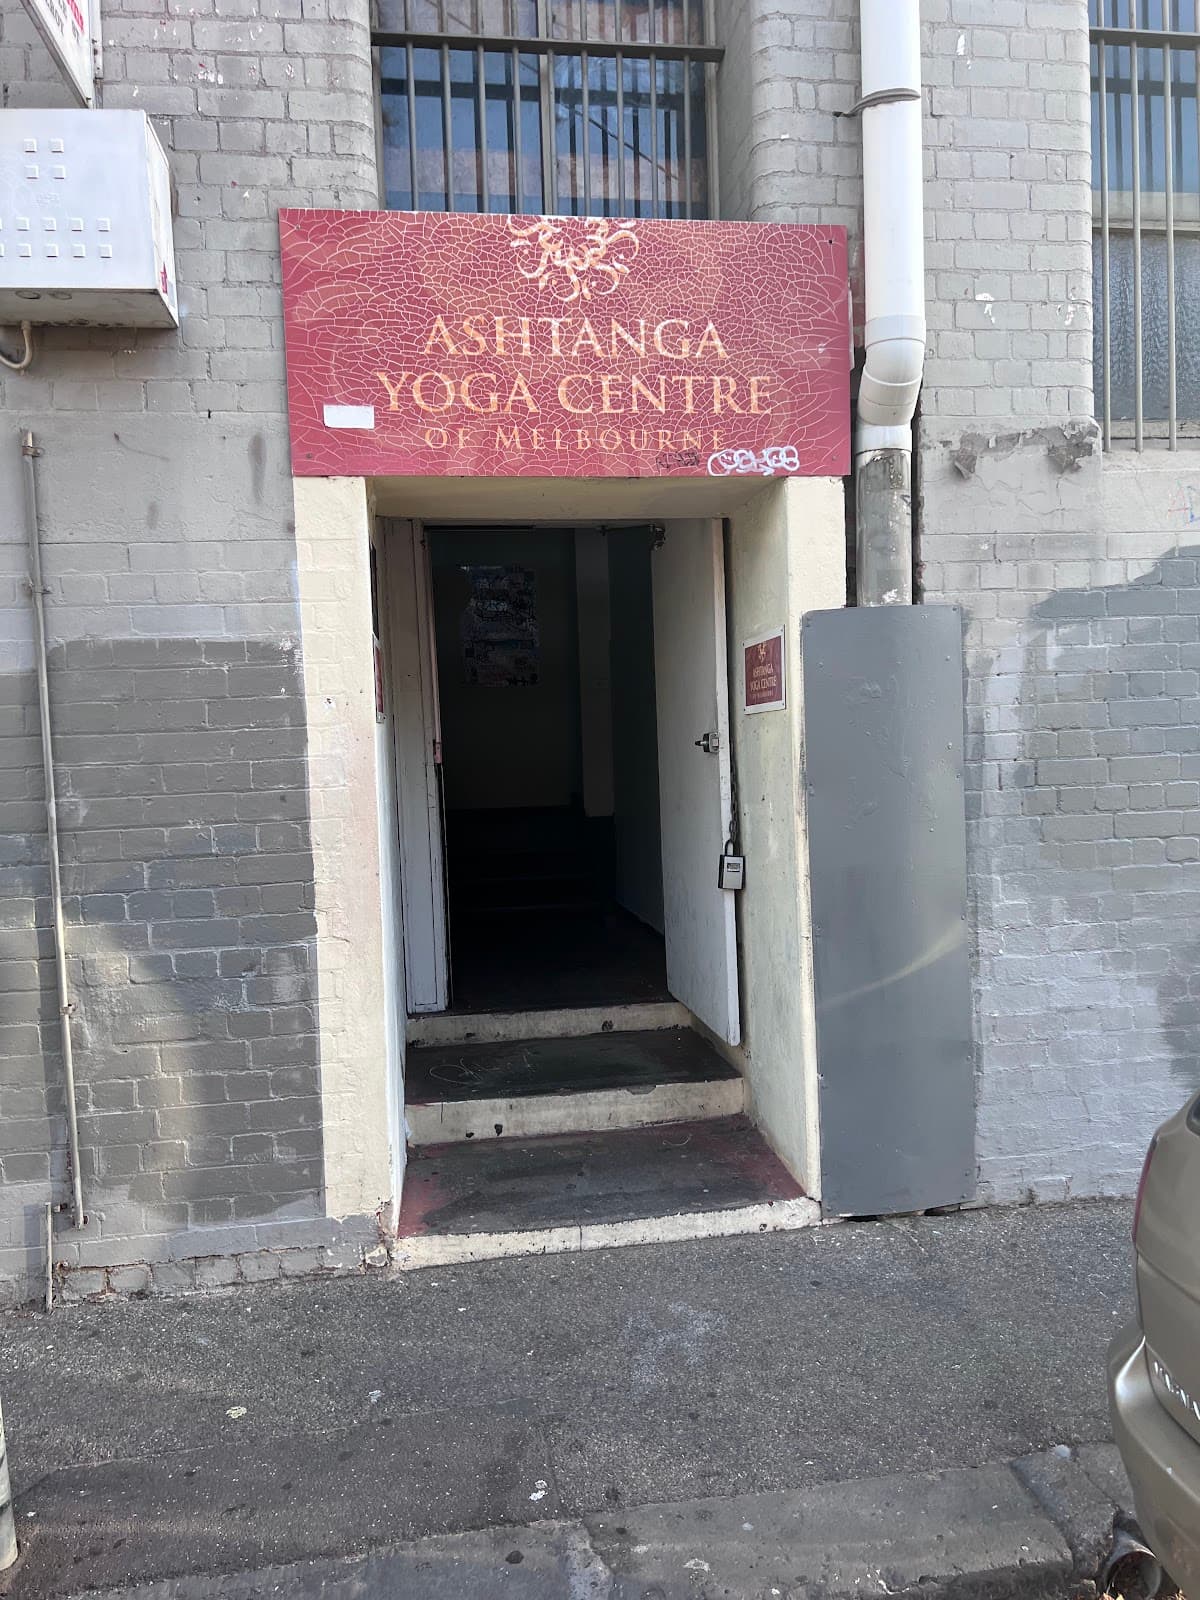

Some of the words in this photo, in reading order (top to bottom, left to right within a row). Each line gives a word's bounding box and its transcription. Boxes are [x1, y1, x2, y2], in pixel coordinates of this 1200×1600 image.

[423, 313, 730, 361] ASHTANGA
[372, 369, 541, 414] YOGA
[556, 373, 774, 416] CENTRE
[424, 427, 472, 449] OF
[495, 425, 726, 451] MELBOURNE
